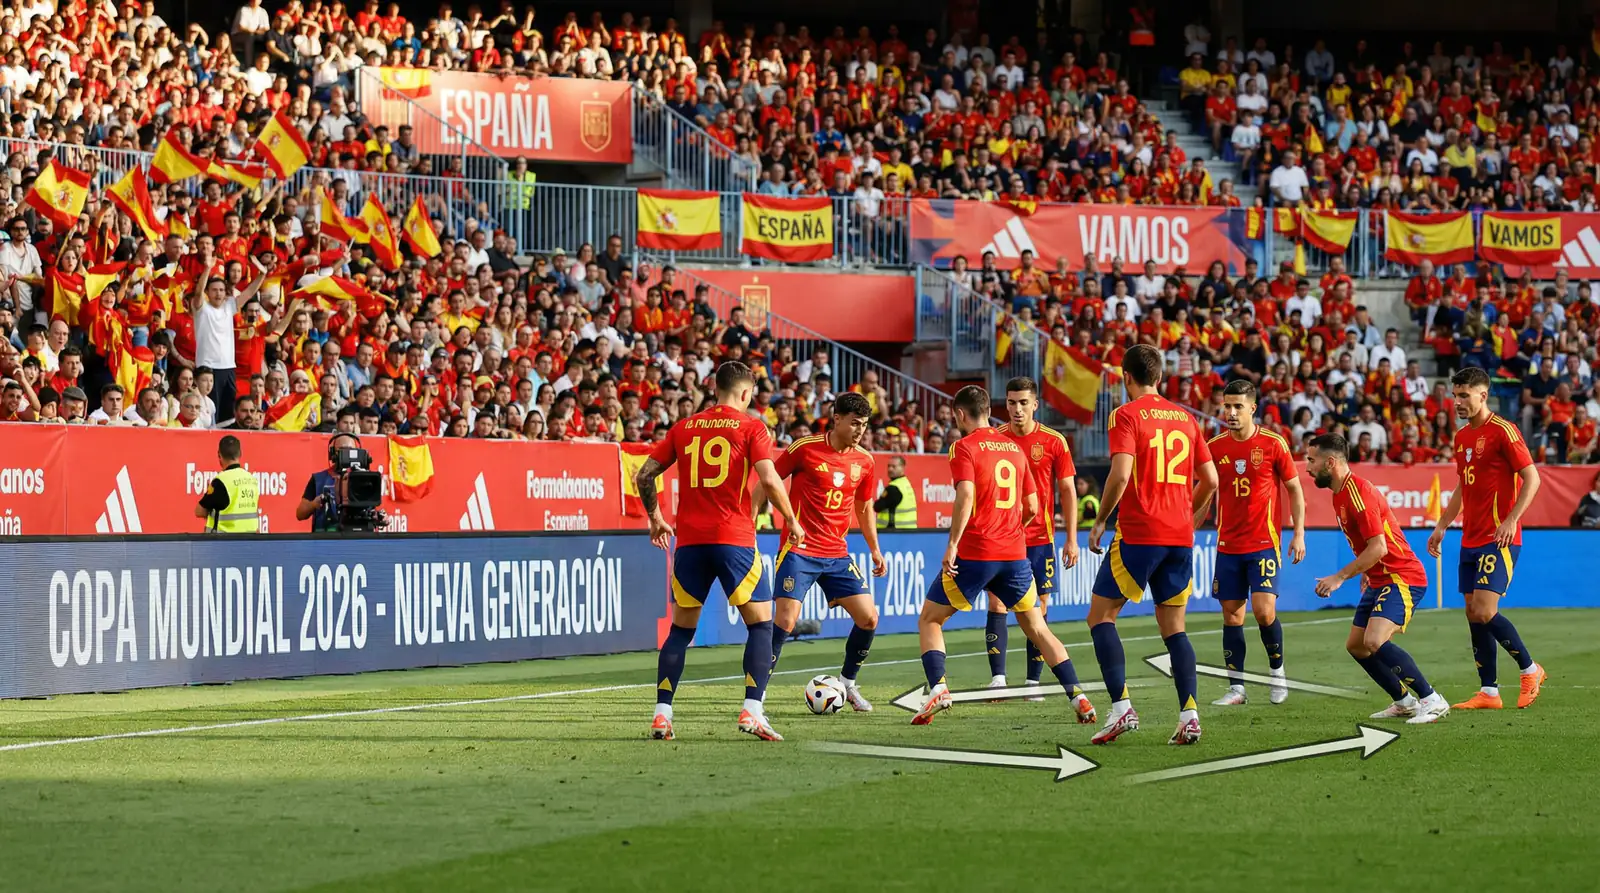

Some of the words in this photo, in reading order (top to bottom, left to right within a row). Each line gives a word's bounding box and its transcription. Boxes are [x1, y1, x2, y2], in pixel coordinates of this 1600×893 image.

[440, 82, 553, 149] ESPAÑA
[758, 214, 825, 241] ESPAÑA
[1078, 214, 1190, 266] VAMOS
[1488, 219, 1554, 247] VAMOS
[685, 436, 731, 488] 19
[1149, 428, 1190, 485] 12
[1463, 466, 1475, 485] 16
[825, 488, 843, 510] 19
[995, 459, 1017, 509] 9
[884, 551, 925, 616] 2026
[1045, 558, 1054, 578] 5
[1258, 558, 1276, 577] 19
[1477, 554, 1497, 574] 18
[50, 570, 137, 668] COPA
[149, 566, 291, 661] MUNDIAL
[299, 564, 367, 651] 2026
[395, 562, 475, 646] NUEVA
[482, 540, 622, 641] GENERACIÓN
